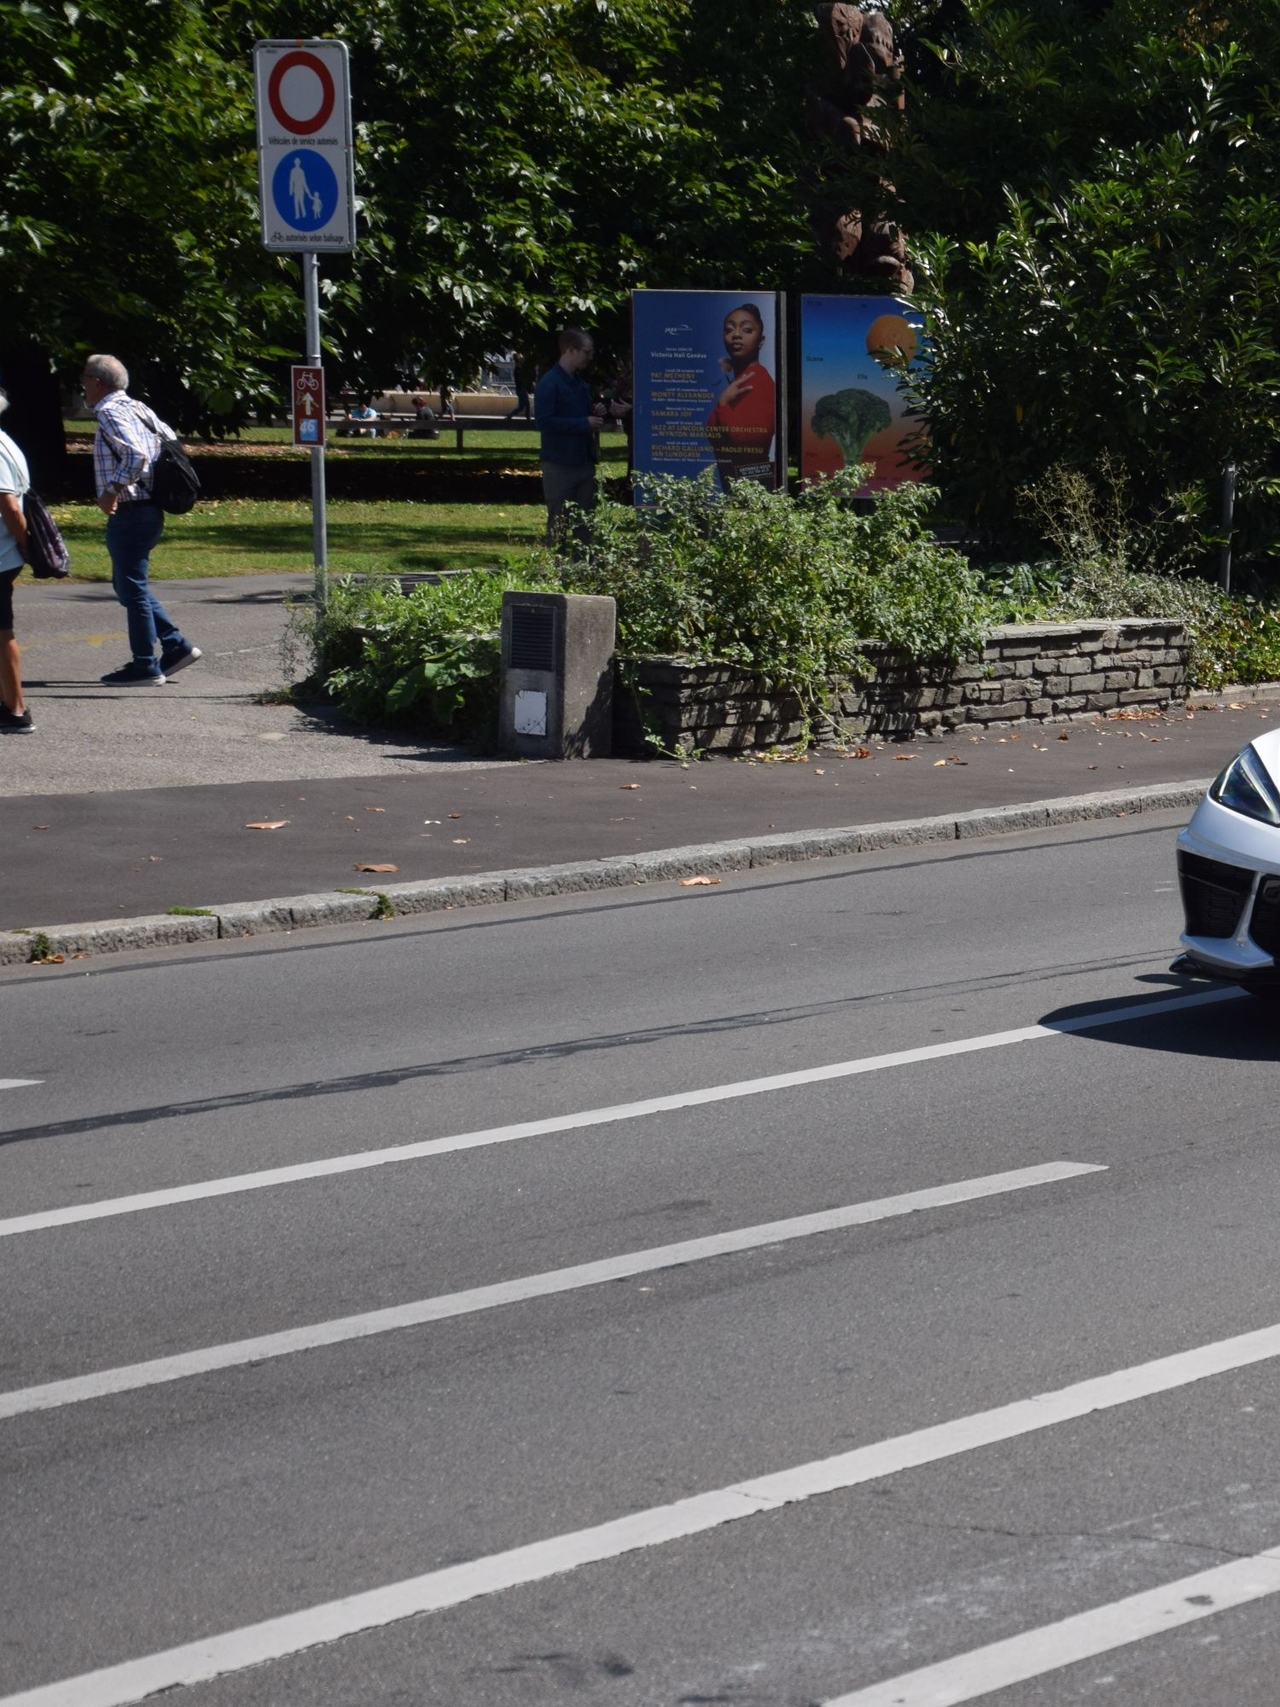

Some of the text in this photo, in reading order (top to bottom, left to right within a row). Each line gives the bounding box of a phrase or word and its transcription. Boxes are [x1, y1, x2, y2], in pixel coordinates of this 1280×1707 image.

[292, 137, 299, 145] de
[300, 137, 315, 145] service
[300, 420, 314, 432] 46
